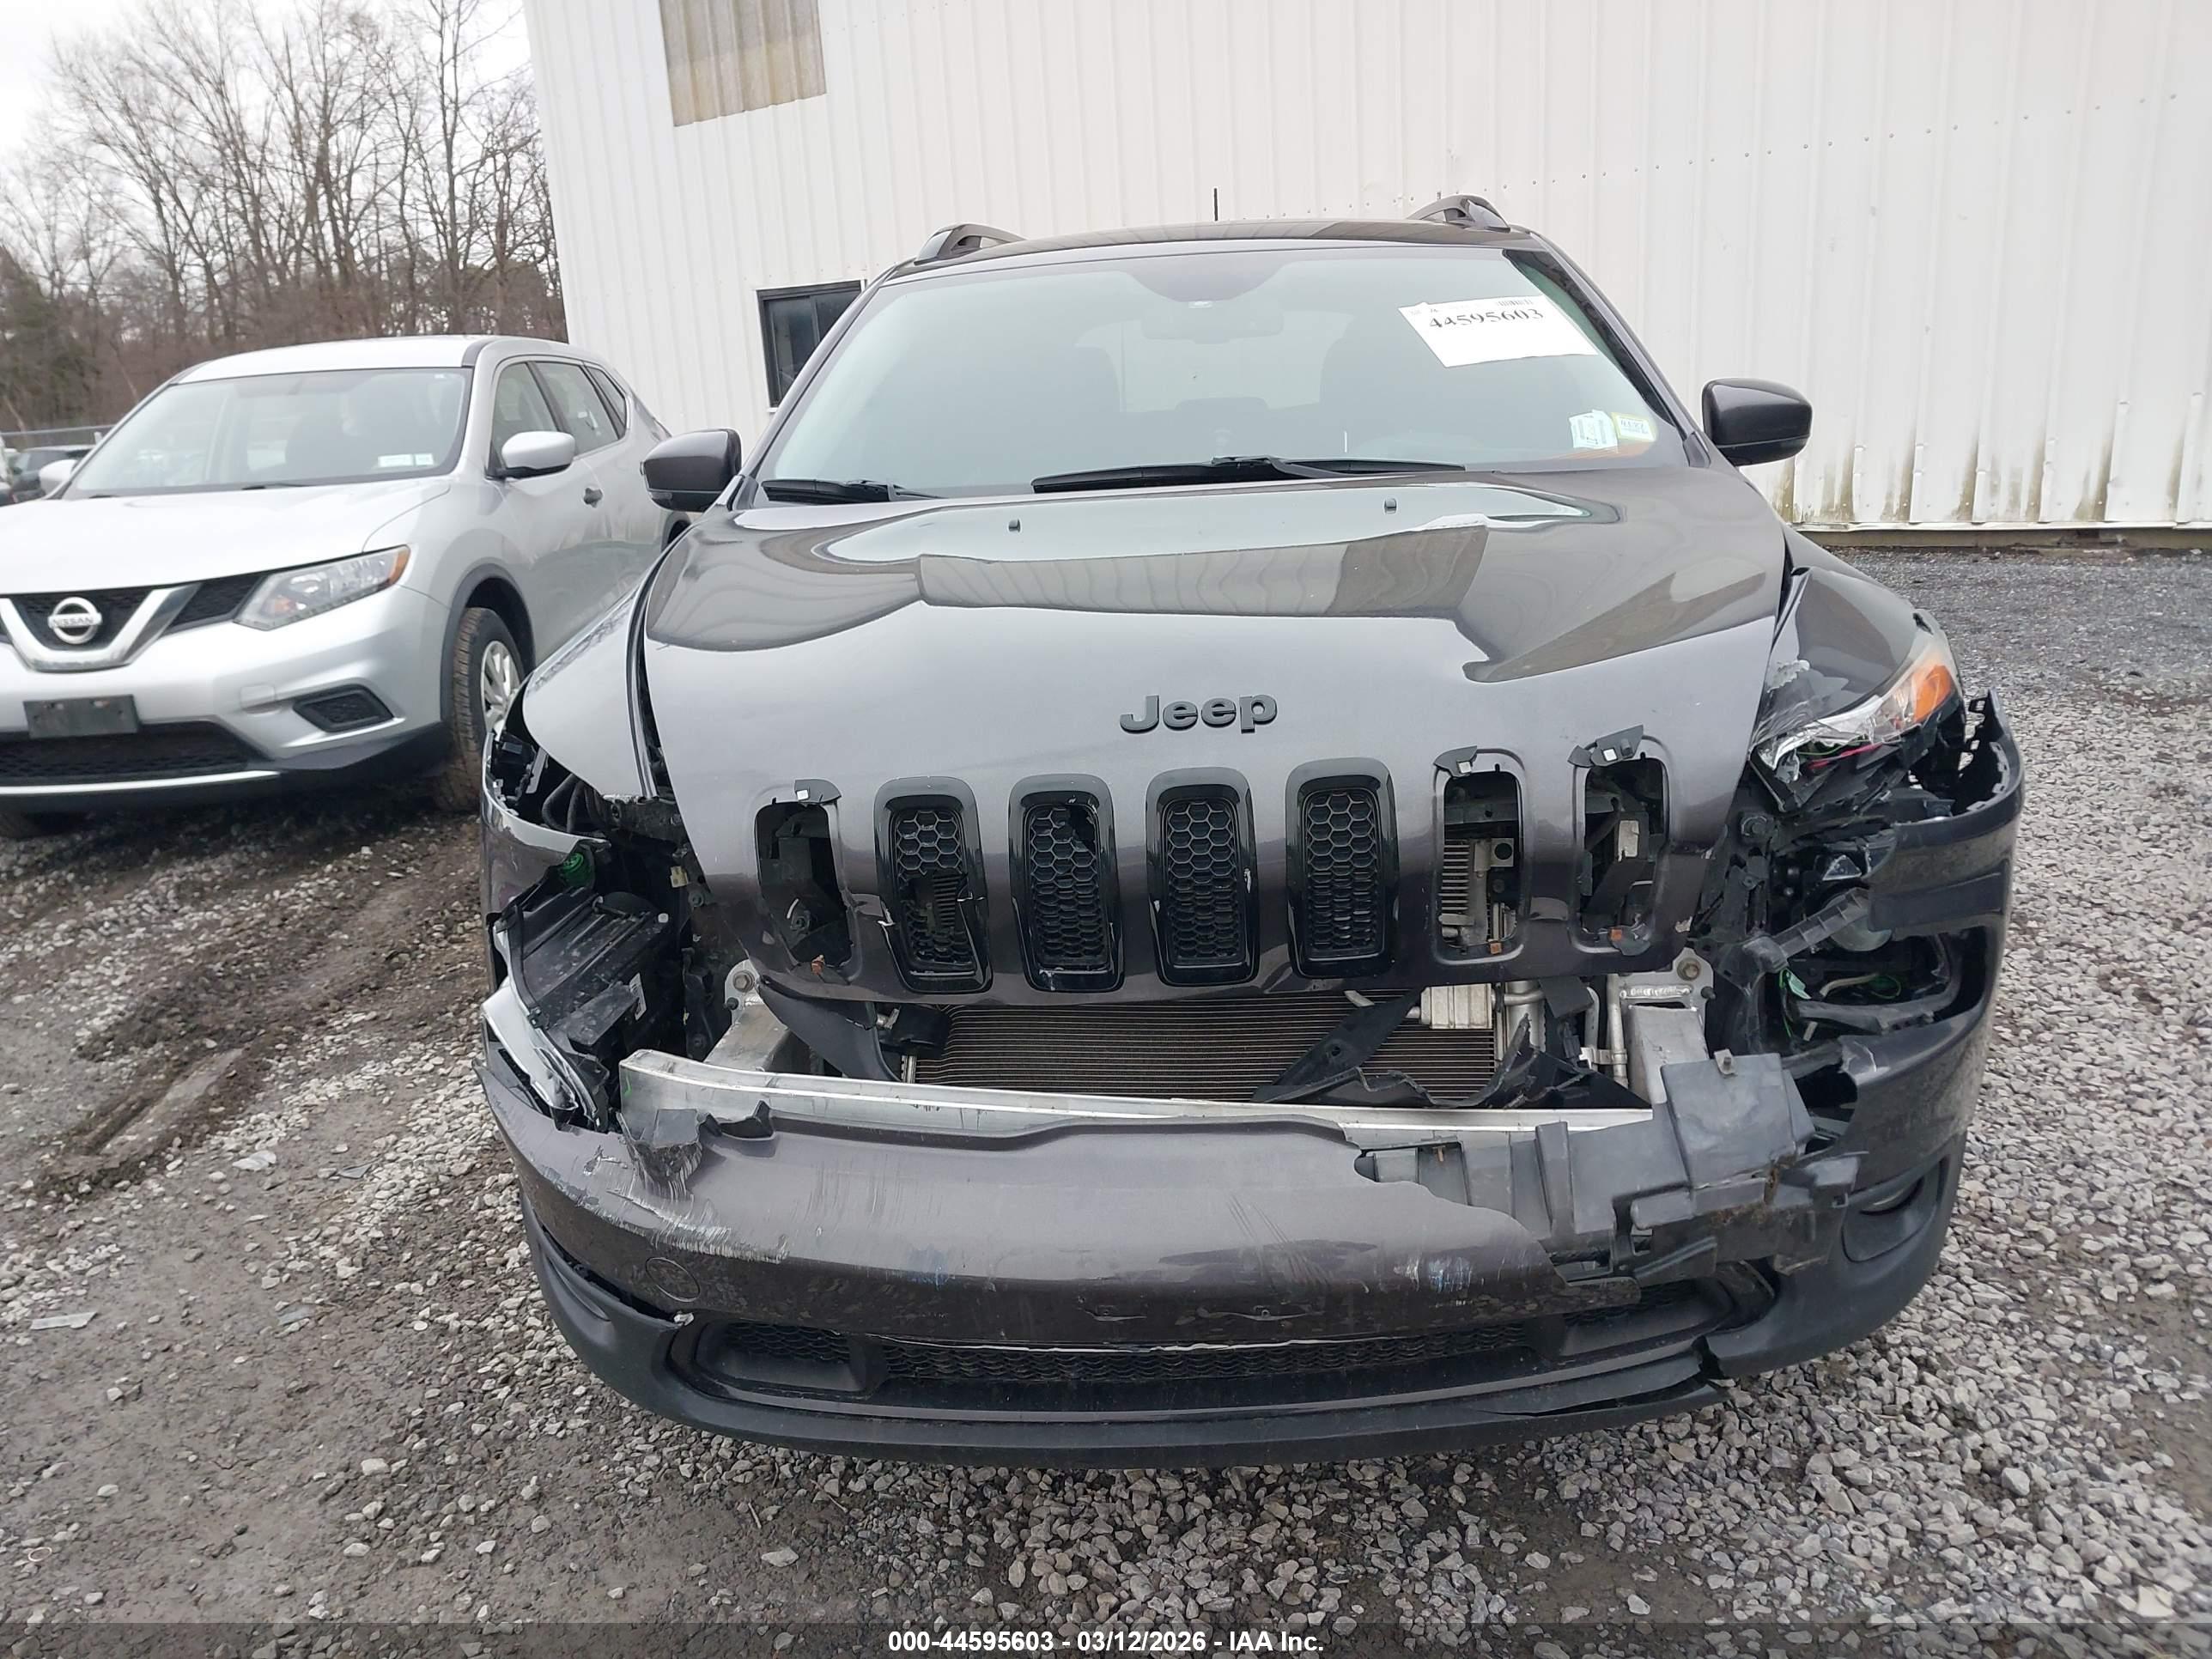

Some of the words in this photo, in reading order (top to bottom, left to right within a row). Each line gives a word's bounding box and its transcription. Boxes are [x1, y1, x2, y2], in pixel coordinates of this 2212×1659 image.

[1429, 307, 1544, 328] 44595603
[52, 617, 92, 627] NISSAN
[1120, 694, 1278, 734] Jeep
